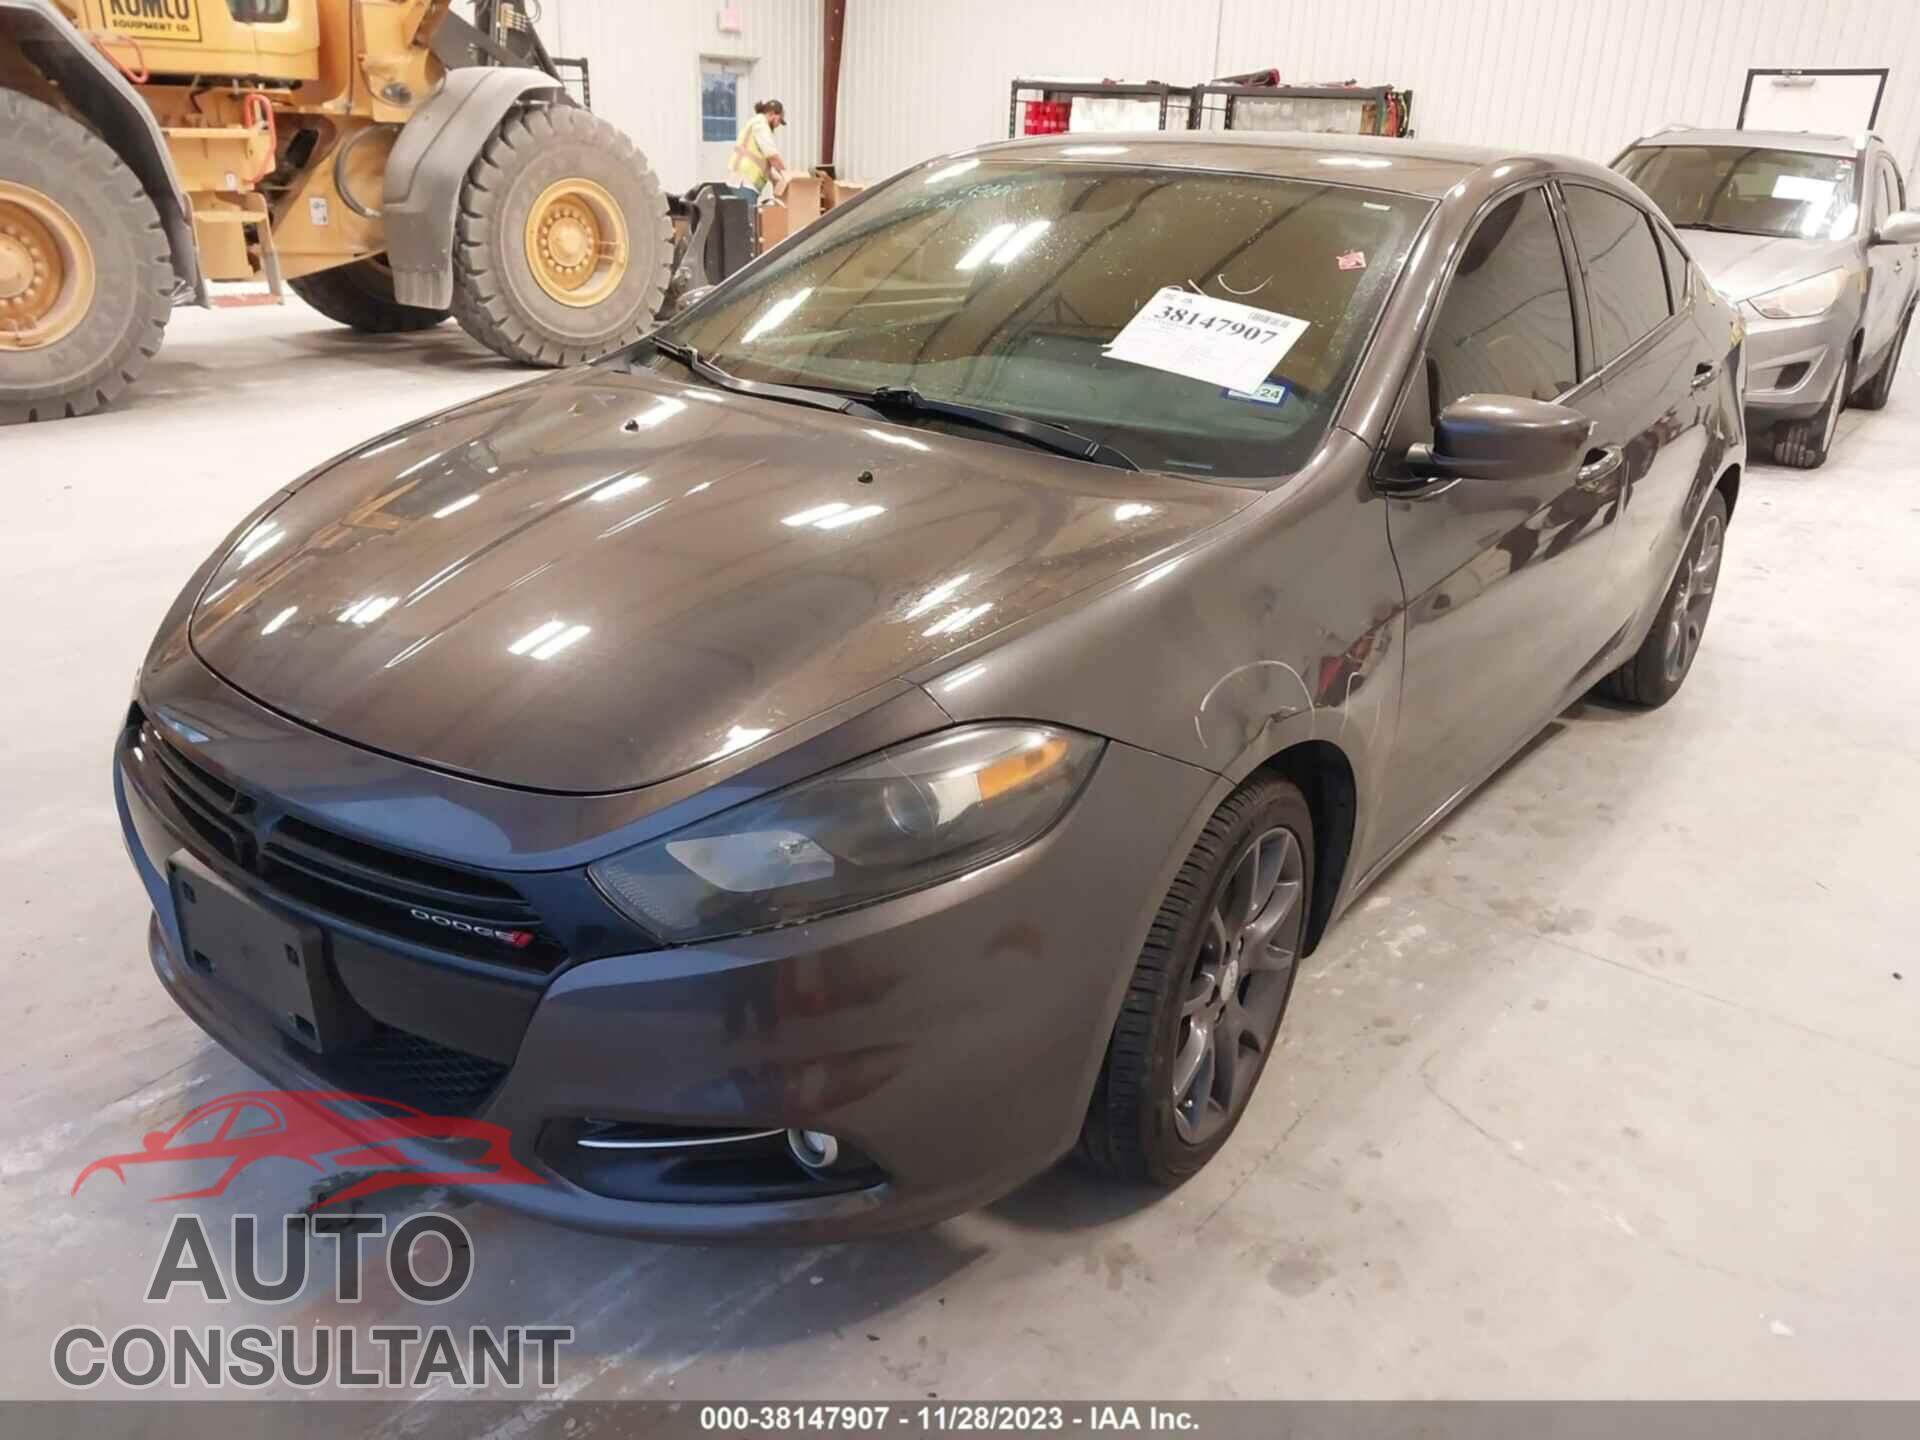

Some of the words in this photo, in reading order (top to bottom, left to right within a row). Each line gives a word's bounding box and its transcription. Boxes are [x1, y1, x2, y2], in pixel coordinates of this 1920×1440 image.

[112, 19, 172, 31] EQUIPMENT
[1153, 305, 1278, 345] 38147907
[411, 908, 515, 942] DODGE
